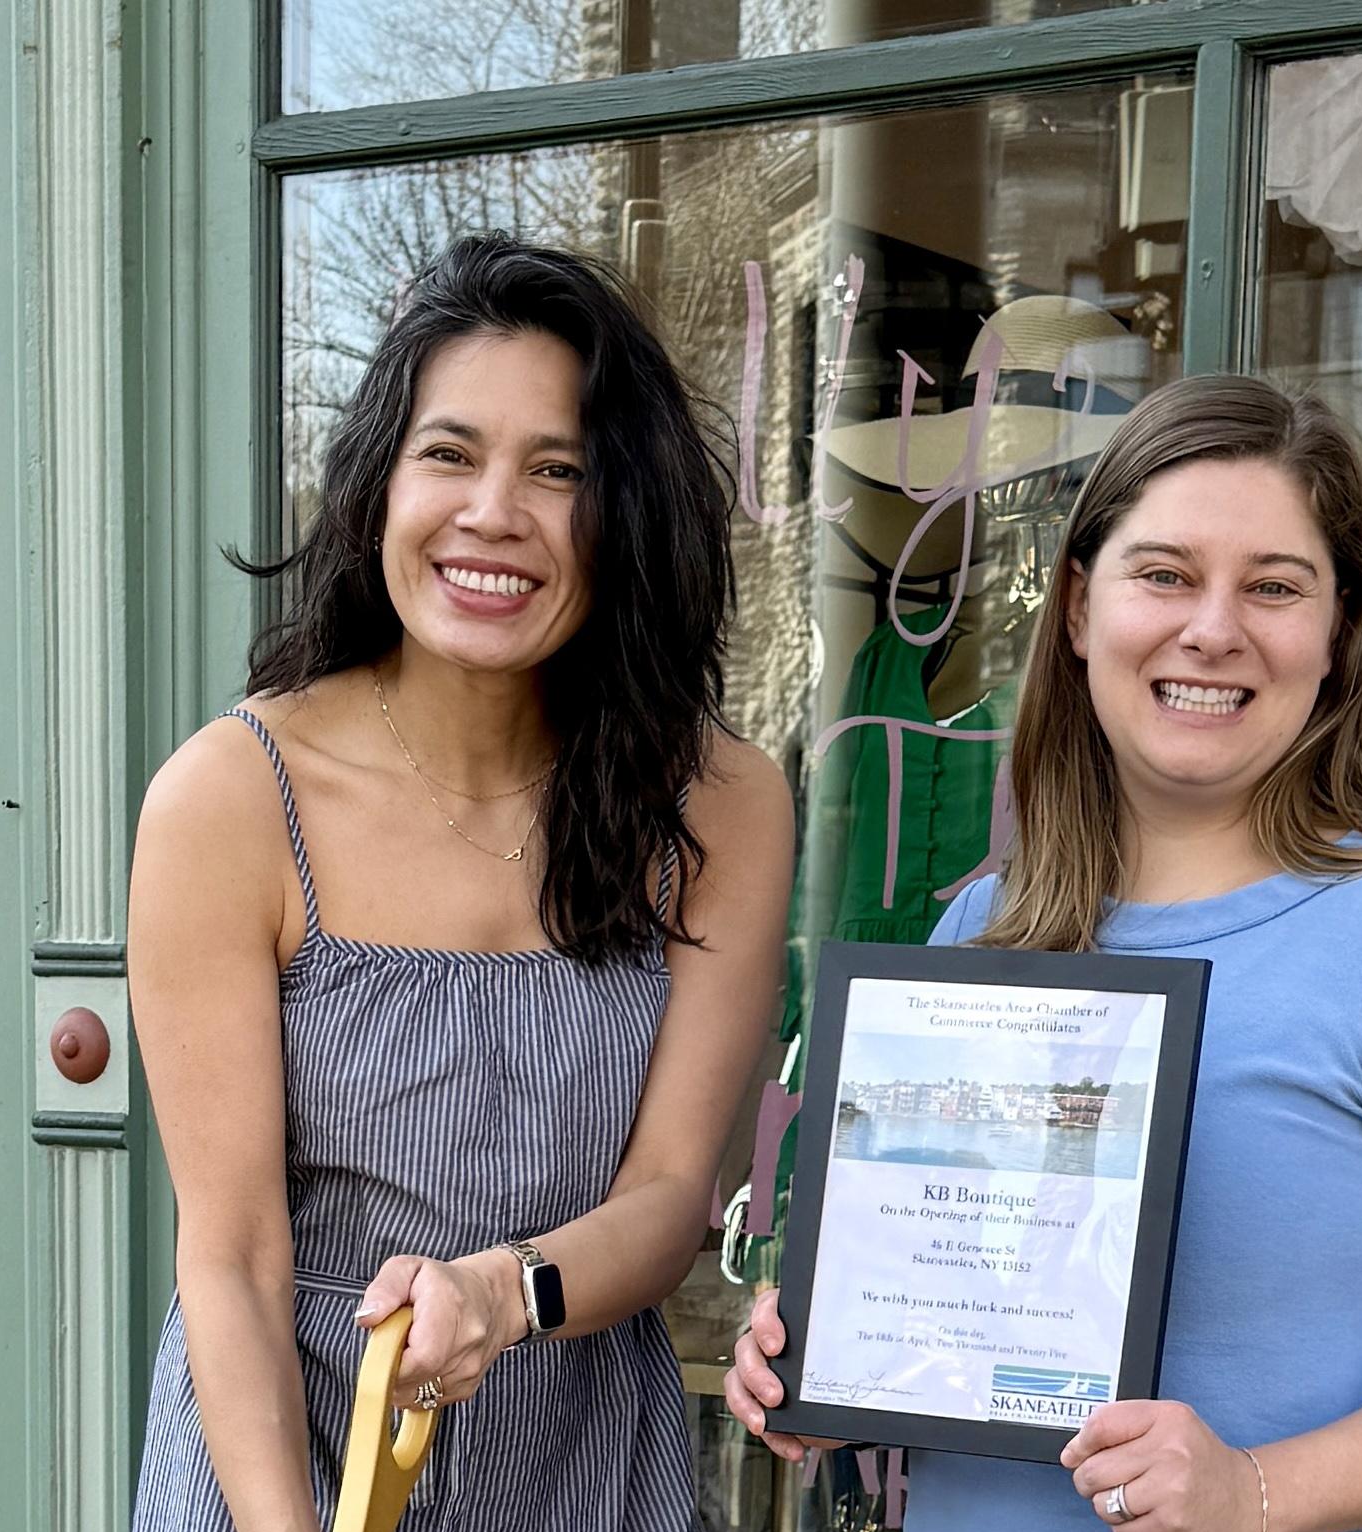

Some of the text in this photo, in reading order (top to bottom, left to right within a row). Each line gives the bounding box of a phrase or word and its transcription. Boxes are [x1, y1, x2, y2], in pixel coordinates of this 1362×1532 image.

[907, 996, 930, 1009] The
[1005, 1000, 1033, 1013] Area
[1036, 1002, 1093, 1017] Chamber
[1095, 1006, 1109, 1018] of
[930, 1014, 1081, 1034] Commerce Congratulates
[923, 1184, 1037, 1212] KB Boutique
[880, 1203, 1076, 1229] On the Opening of their Business at
[980, 1258, 999, 1271] NY
[862, 1290, 1075, 1320] We wish you much luck and success!
[989, 1394, 1096, 1419] SKANEATEL
